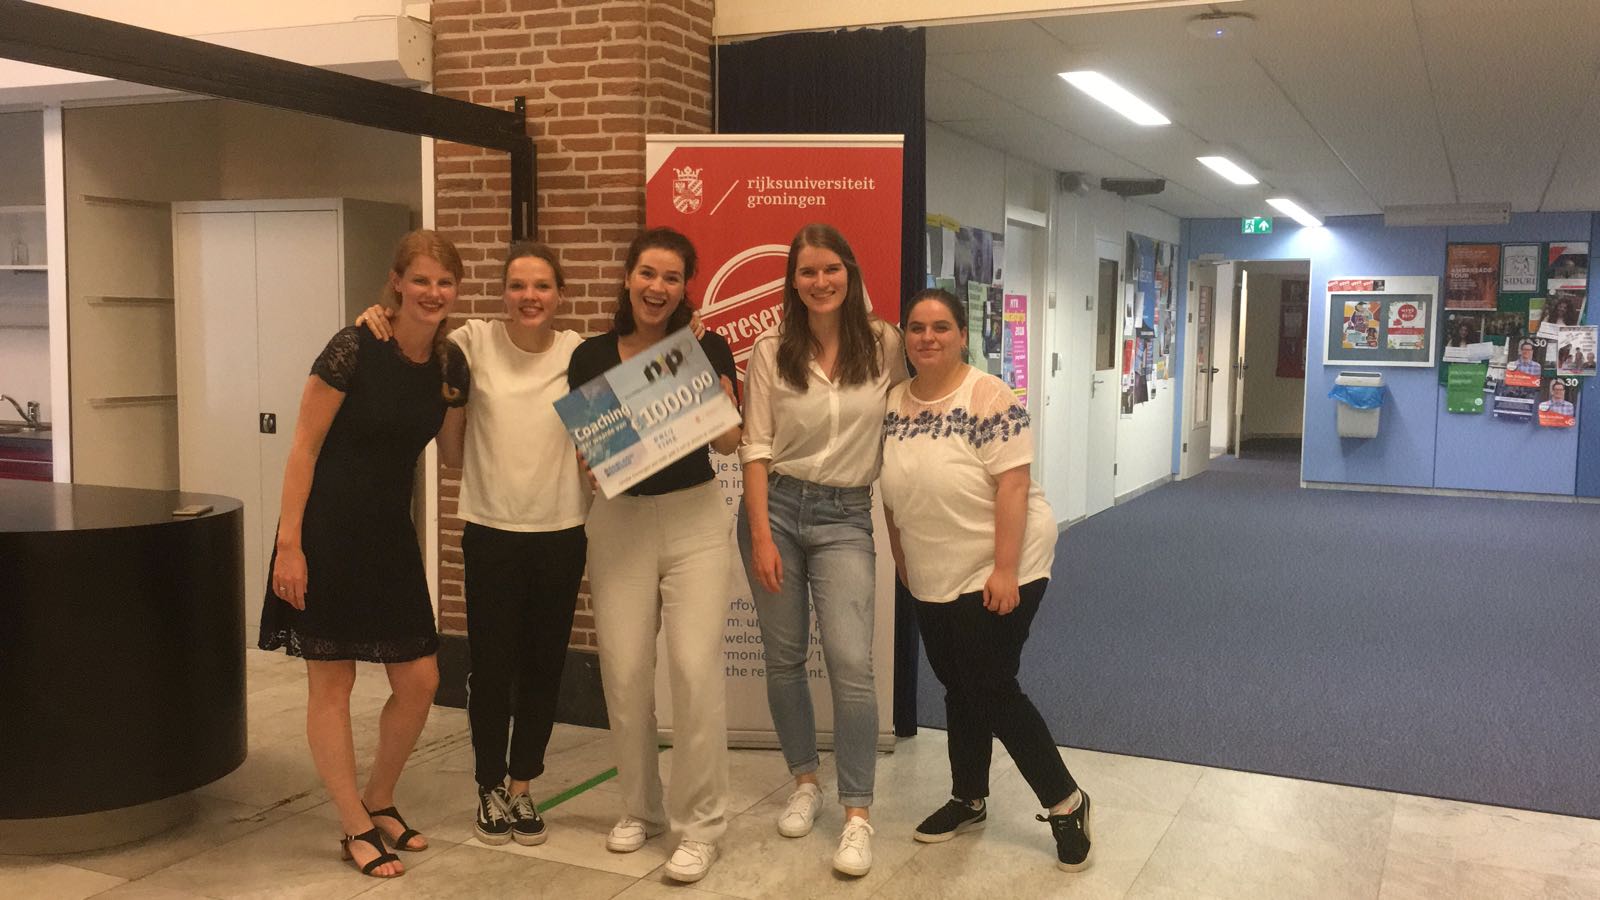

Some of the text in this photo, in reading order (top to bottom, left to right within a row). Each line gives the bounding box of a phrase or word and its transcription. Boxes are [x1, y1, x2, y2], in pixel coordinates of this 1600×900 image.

[747, 176, 876, 192] rijksuniversiteit
[747, 192, 826, 209] groningen
[706, 303, 784, 345] ereser
[1534, 339, 1547, 347] 30
[1565, 379, 1579, 387] 30
[574, 403, 632, 442] Coaching
[726, 665, 748, 677] the
